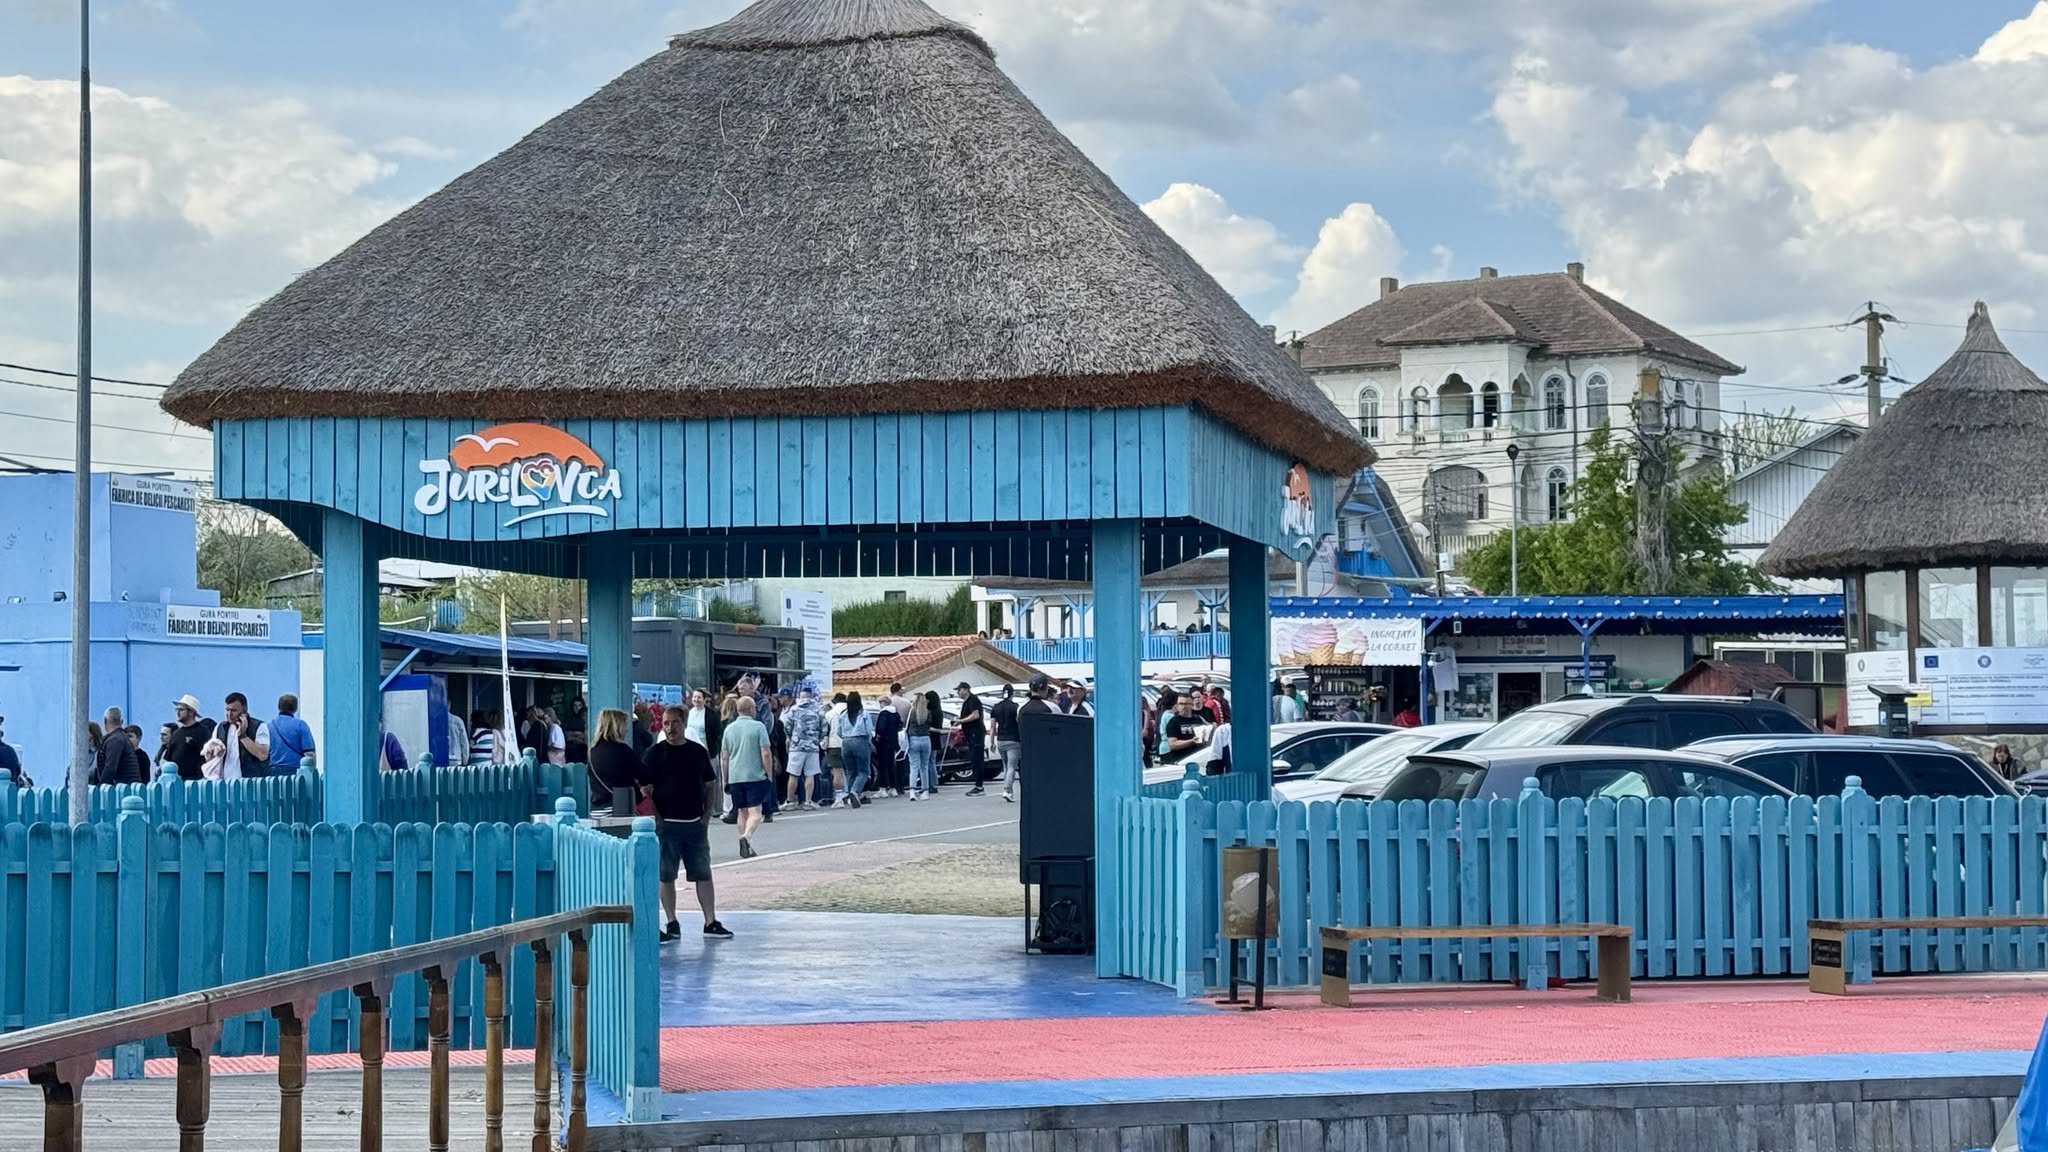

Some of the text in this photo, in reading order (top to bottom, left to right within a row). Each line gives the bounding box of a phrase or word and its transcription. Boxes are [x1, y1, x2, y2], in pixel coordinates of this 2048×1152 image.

[112, 487, 135, 504] FABRICA
[136, 491, 143, 505] DE
[144, 492, 163, 508] DELICII
[200, 609, 216, 618] GURA
[168, 619, 196, 634] FABRICA
[198, 621, 207, 635] DE
[207, 621, 230, 636] DELICII
[231, 622, 269, 637] PESCARESTI
[1371, 643, 1416, 651] LA CORNET
